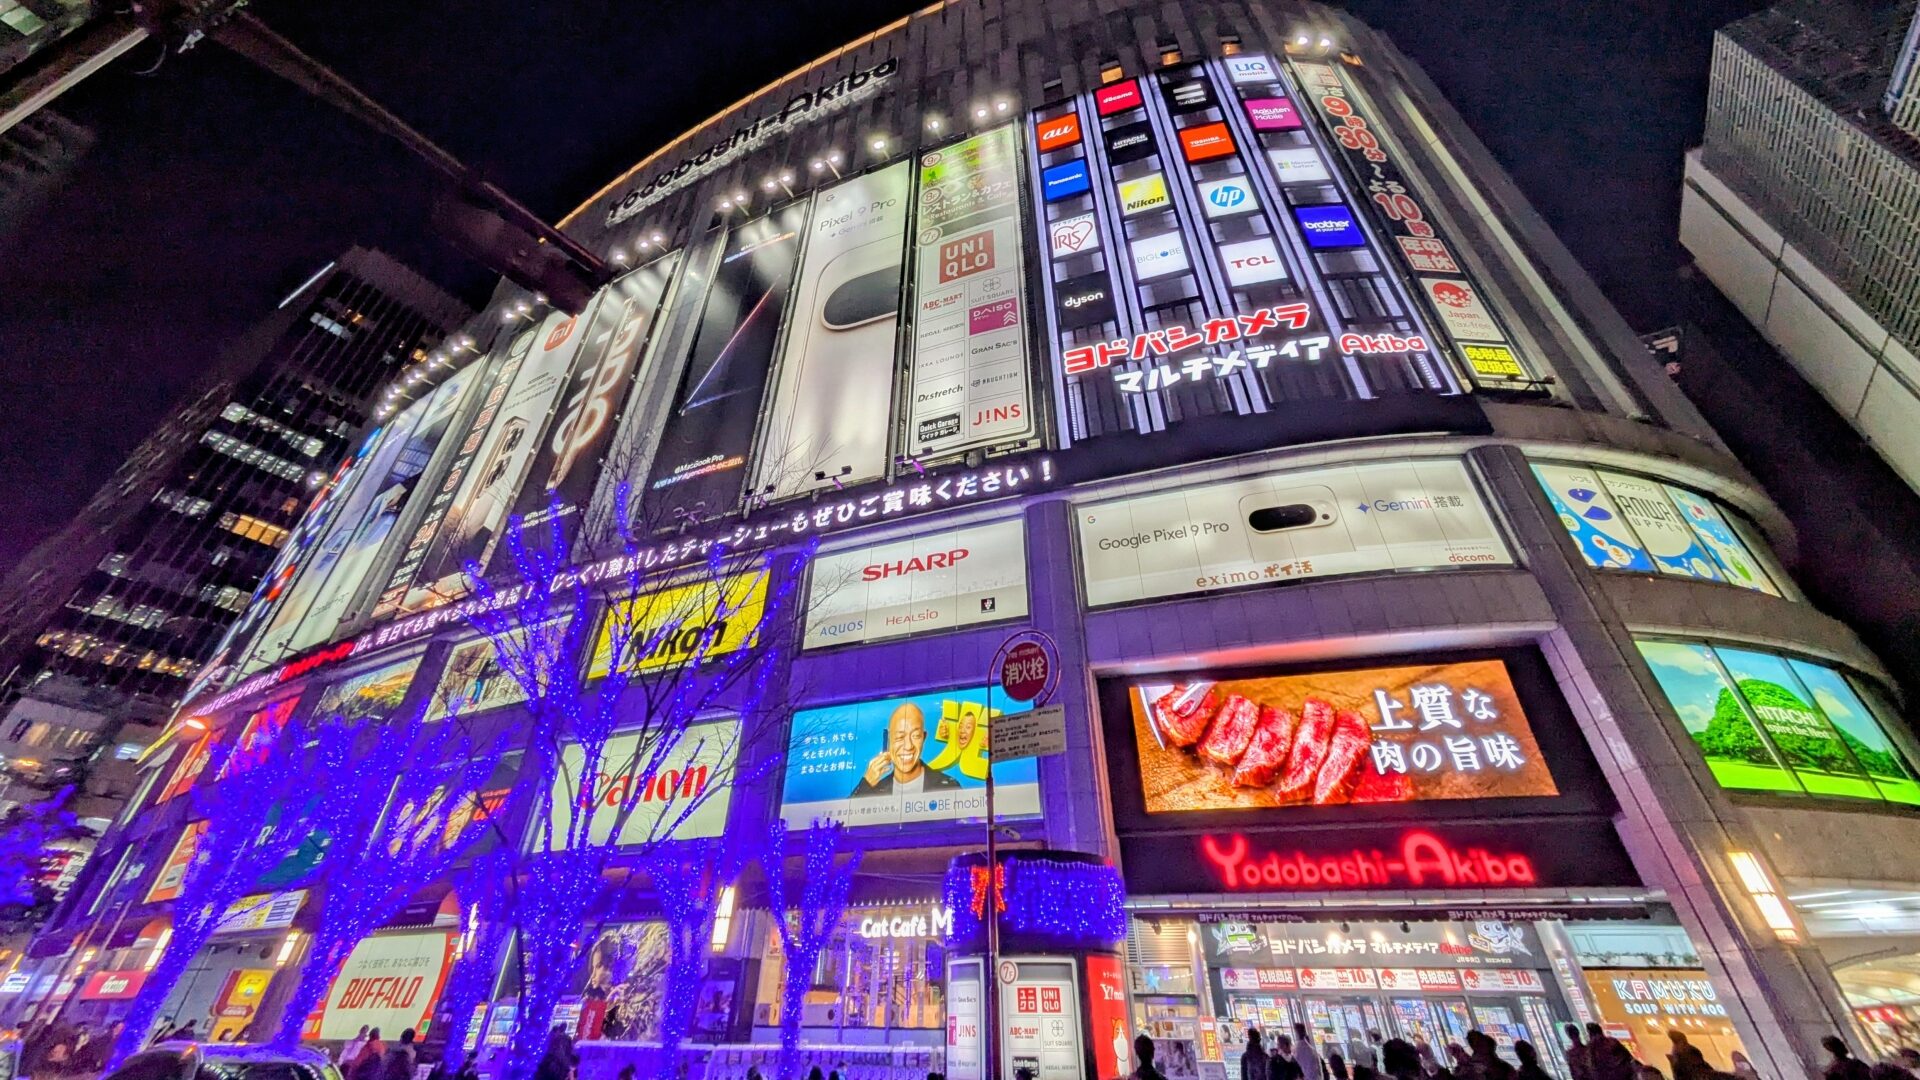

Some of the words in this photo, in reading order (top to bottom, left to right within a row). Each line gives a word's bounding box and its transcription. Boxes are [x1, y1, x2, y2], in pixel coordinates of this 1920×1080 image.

[1235, 62, 1266, 74] UQ
[1252, 106, 1290, 116] Rakuten
[1042, 123, 1075, 141] au
[1189, 135, 1220, 146] TOSHIBA
[1048, 171, 1083, 187] Panasonic
[1126, 194, 1165, 212] Nikon
[1215, 184, 1240, 208] hp
[819, 210, 853, 232] Pixel
[857, 206, 867, 217] 9
[871, 198, 897, 213] Pro
[1303, 220, 1350, 230] brother
[945, 237, 986, 260] UNI
[1401, 238, 1440, 253] 年中
[1136, 247, 1183, 265] BIGLOBE
[1229, 255, 1275, 270] TCL
[945, 252, 989, 279] QLO
[922, 292, 964, 311] ABC-MART
[1064, 291, 1104, 308] dyson
[973, 302, 1013, 317] DAISO
[1064, 302, 1312, 375] ヨドバシカメラ
[1338, 333, 1428, 356] Akiba
[1113, 335, 1330, 394] マルチメディア
[917, 384, 964, 403] Dr.stretch
[919, 421, 937, 435] Quick
[938, 417, 959, 430] Garage
[1373, 495, 1432, 514] Gemini
[1433, 495, 1464, 509] 搭載
[1098, 533, 1152, 552] Google
[1153, 527, 1188, 542] Pixel
[1189, 525, 1200, 538] 9
[1204, 520, 1230, 535] Pro
[862, 548, 970, 582] SHARP
[1449, 552, 1496, 563] docomo
[1196, 567, 1260, 588] eximo
[819, 619, 864, 637] AQUOS
[1004, 656, 1046, 687] 消火栓
[1369, 683, 1498, 732] 上質な
[1751, 704, 1820, 727] HITACHI
[1371, 735, 1525, 775] 肉の旨味
[904, 798, 951, 814] BIGLOBE
[953, 796, 987, 810] mobil
[1204, 831, 1535, 889] Yodobashi-Akiba
[861, 918, 889, 939] Cat
[889, 914, 927, 938] Café
[1270, 938, 1366, 955] ヨドバシカメラ
[1369, 939, 1439, 955] マルチメディア
[1440, 942, 1473, 955] Akiba
[336, 976, 424, 1010] BUFFALO
[1019, 990, 1036, 1000] ユニ
[1042, 989, 1058, 1000] UNI
[1613, 979, 1717, 1001] KAMUKU
[1019, 1000, 1036, 1011] クロ
[1043, 1000, 1060, 1011] QLO
[1624, 1003, 1659, 1015] SOUP
[1663, 1003, 1697, 1015] WITH
[1009, 1027, 1039, 1036] ABC-MART
